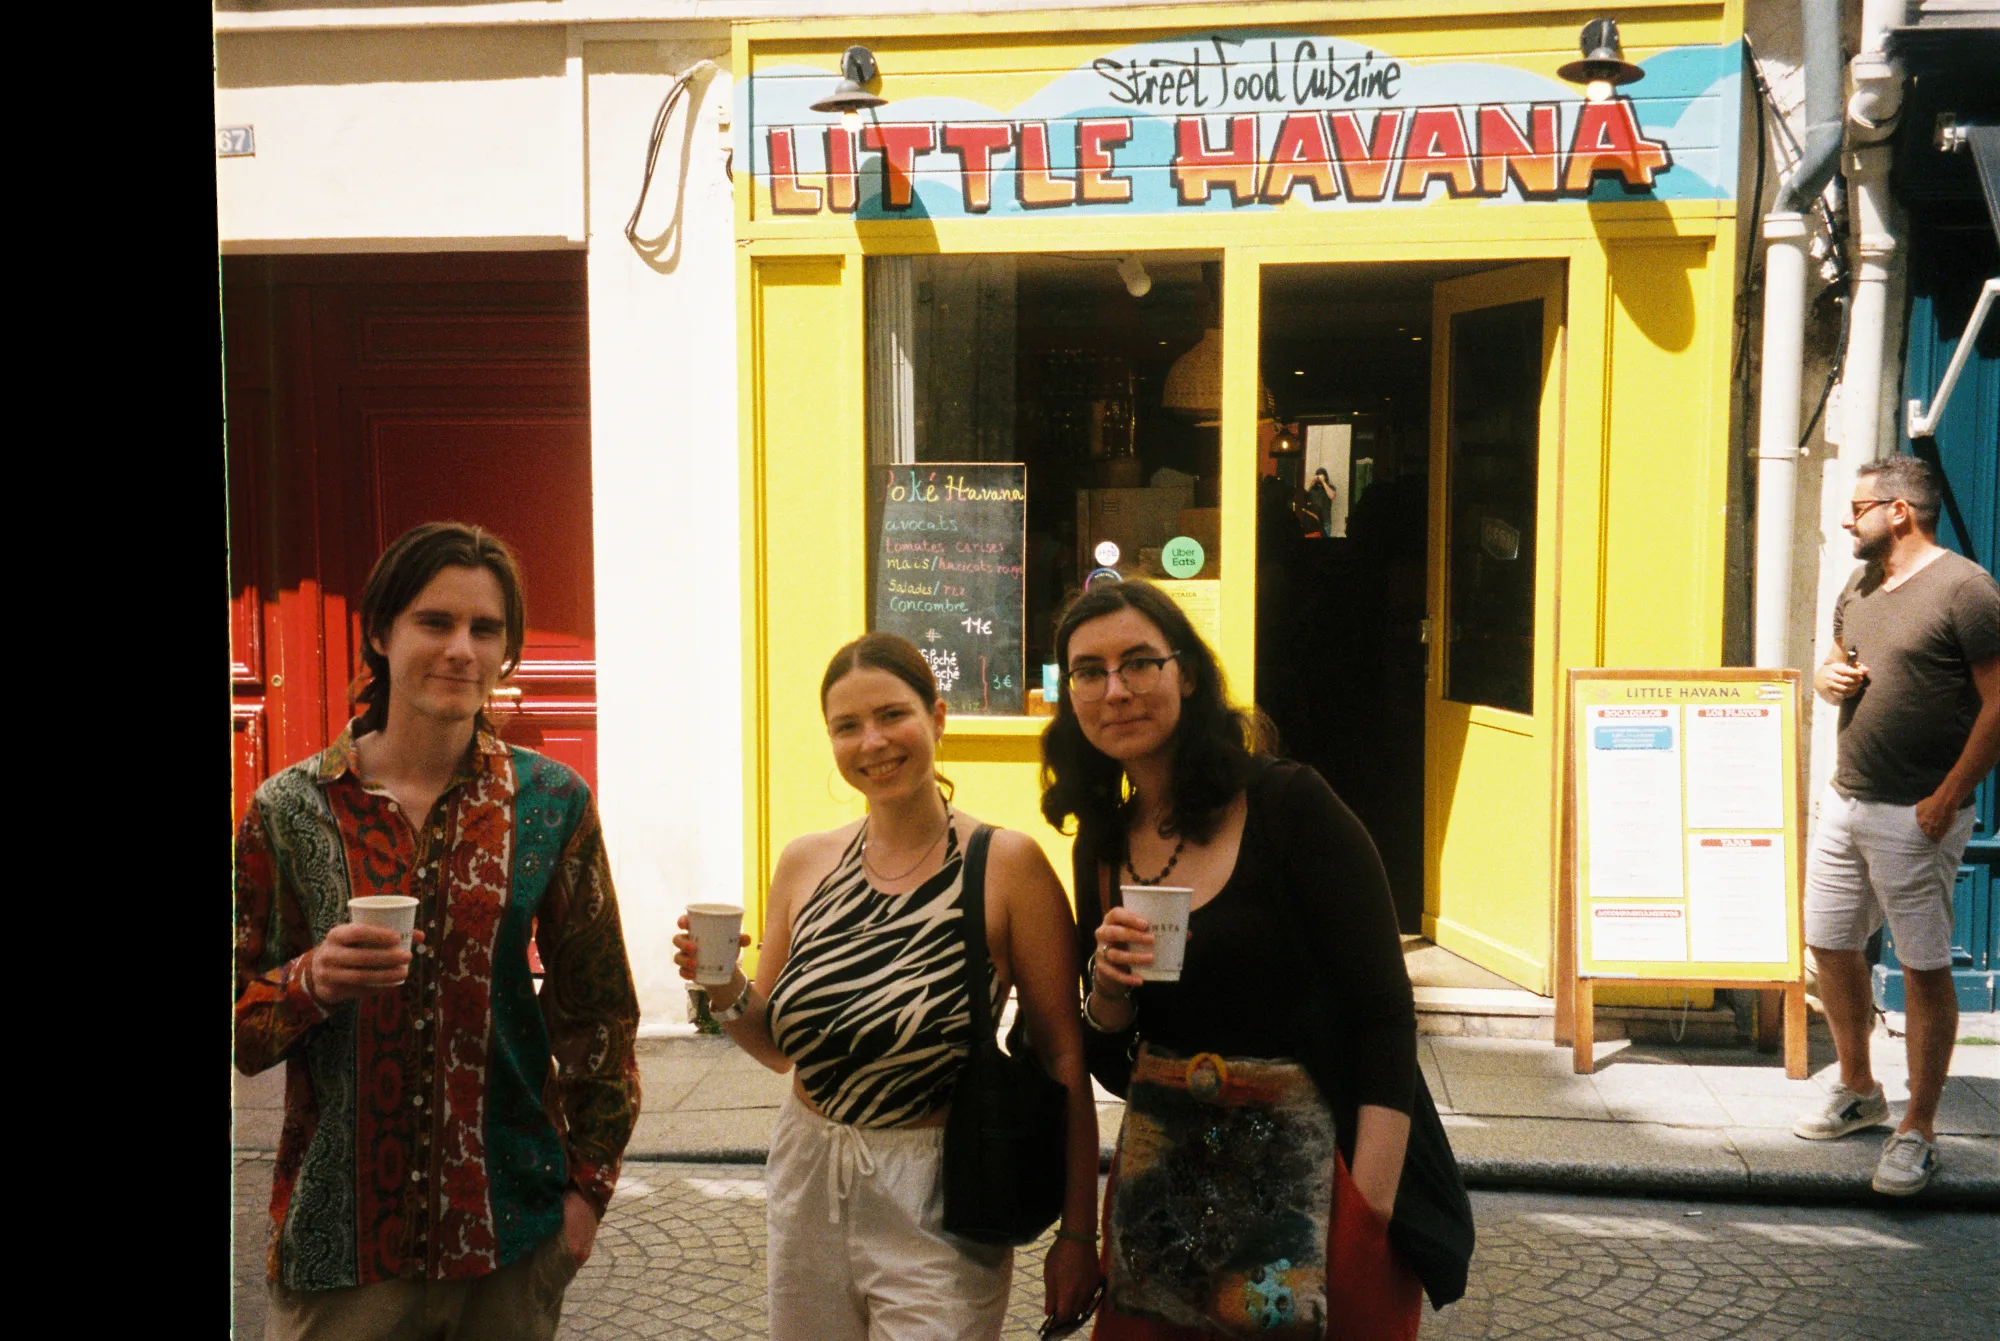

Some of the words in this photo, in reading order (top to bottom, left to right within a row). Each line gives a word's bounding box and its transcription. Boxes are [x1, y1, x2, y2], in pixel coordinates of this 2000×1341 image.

[1092, 46, 1208, 108] Street
[1210, 36, 1288, 110] Food
[218, 129, 246, 153] 67
[766, 117, 1134, 216] LITTLE
[1169, 94, 1673, 208] HAVANA
[945, 475, 1024, 503] Havana
[885, 515, 959, 532] avocats
[1171, 548, 1195, 557] Uber
[1172, 557, 1196, 567] Eats
[889, 596, 969, 613] Concombre
[961, 617, 993, 636] 11€
[1626, 687, 1672, 698] LITTLE
[1680, 687, 1741, 698] HAVANA
